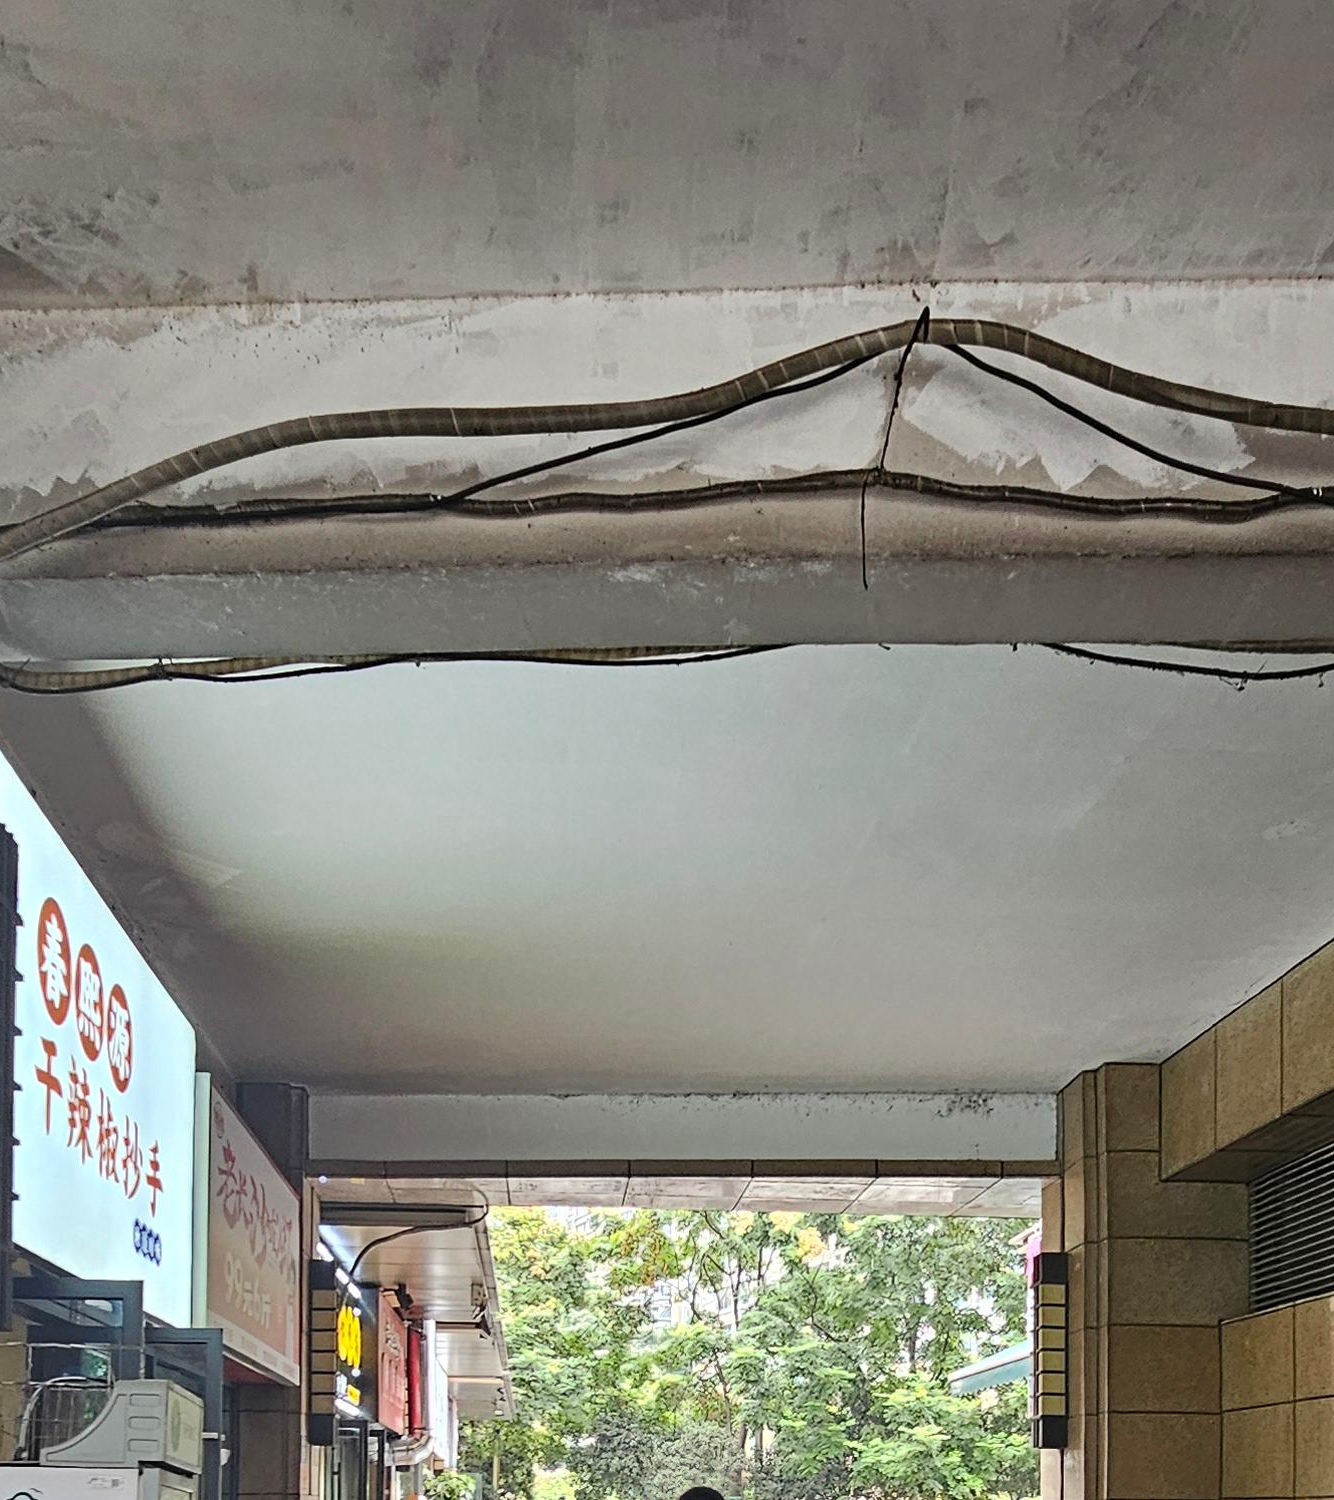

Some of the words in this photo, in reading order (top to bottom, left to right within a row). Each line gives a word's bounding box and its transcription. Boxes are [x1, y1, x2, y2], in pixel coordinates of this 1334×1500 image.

[34, 1035, 164, 1219] 干辣椒抄手
